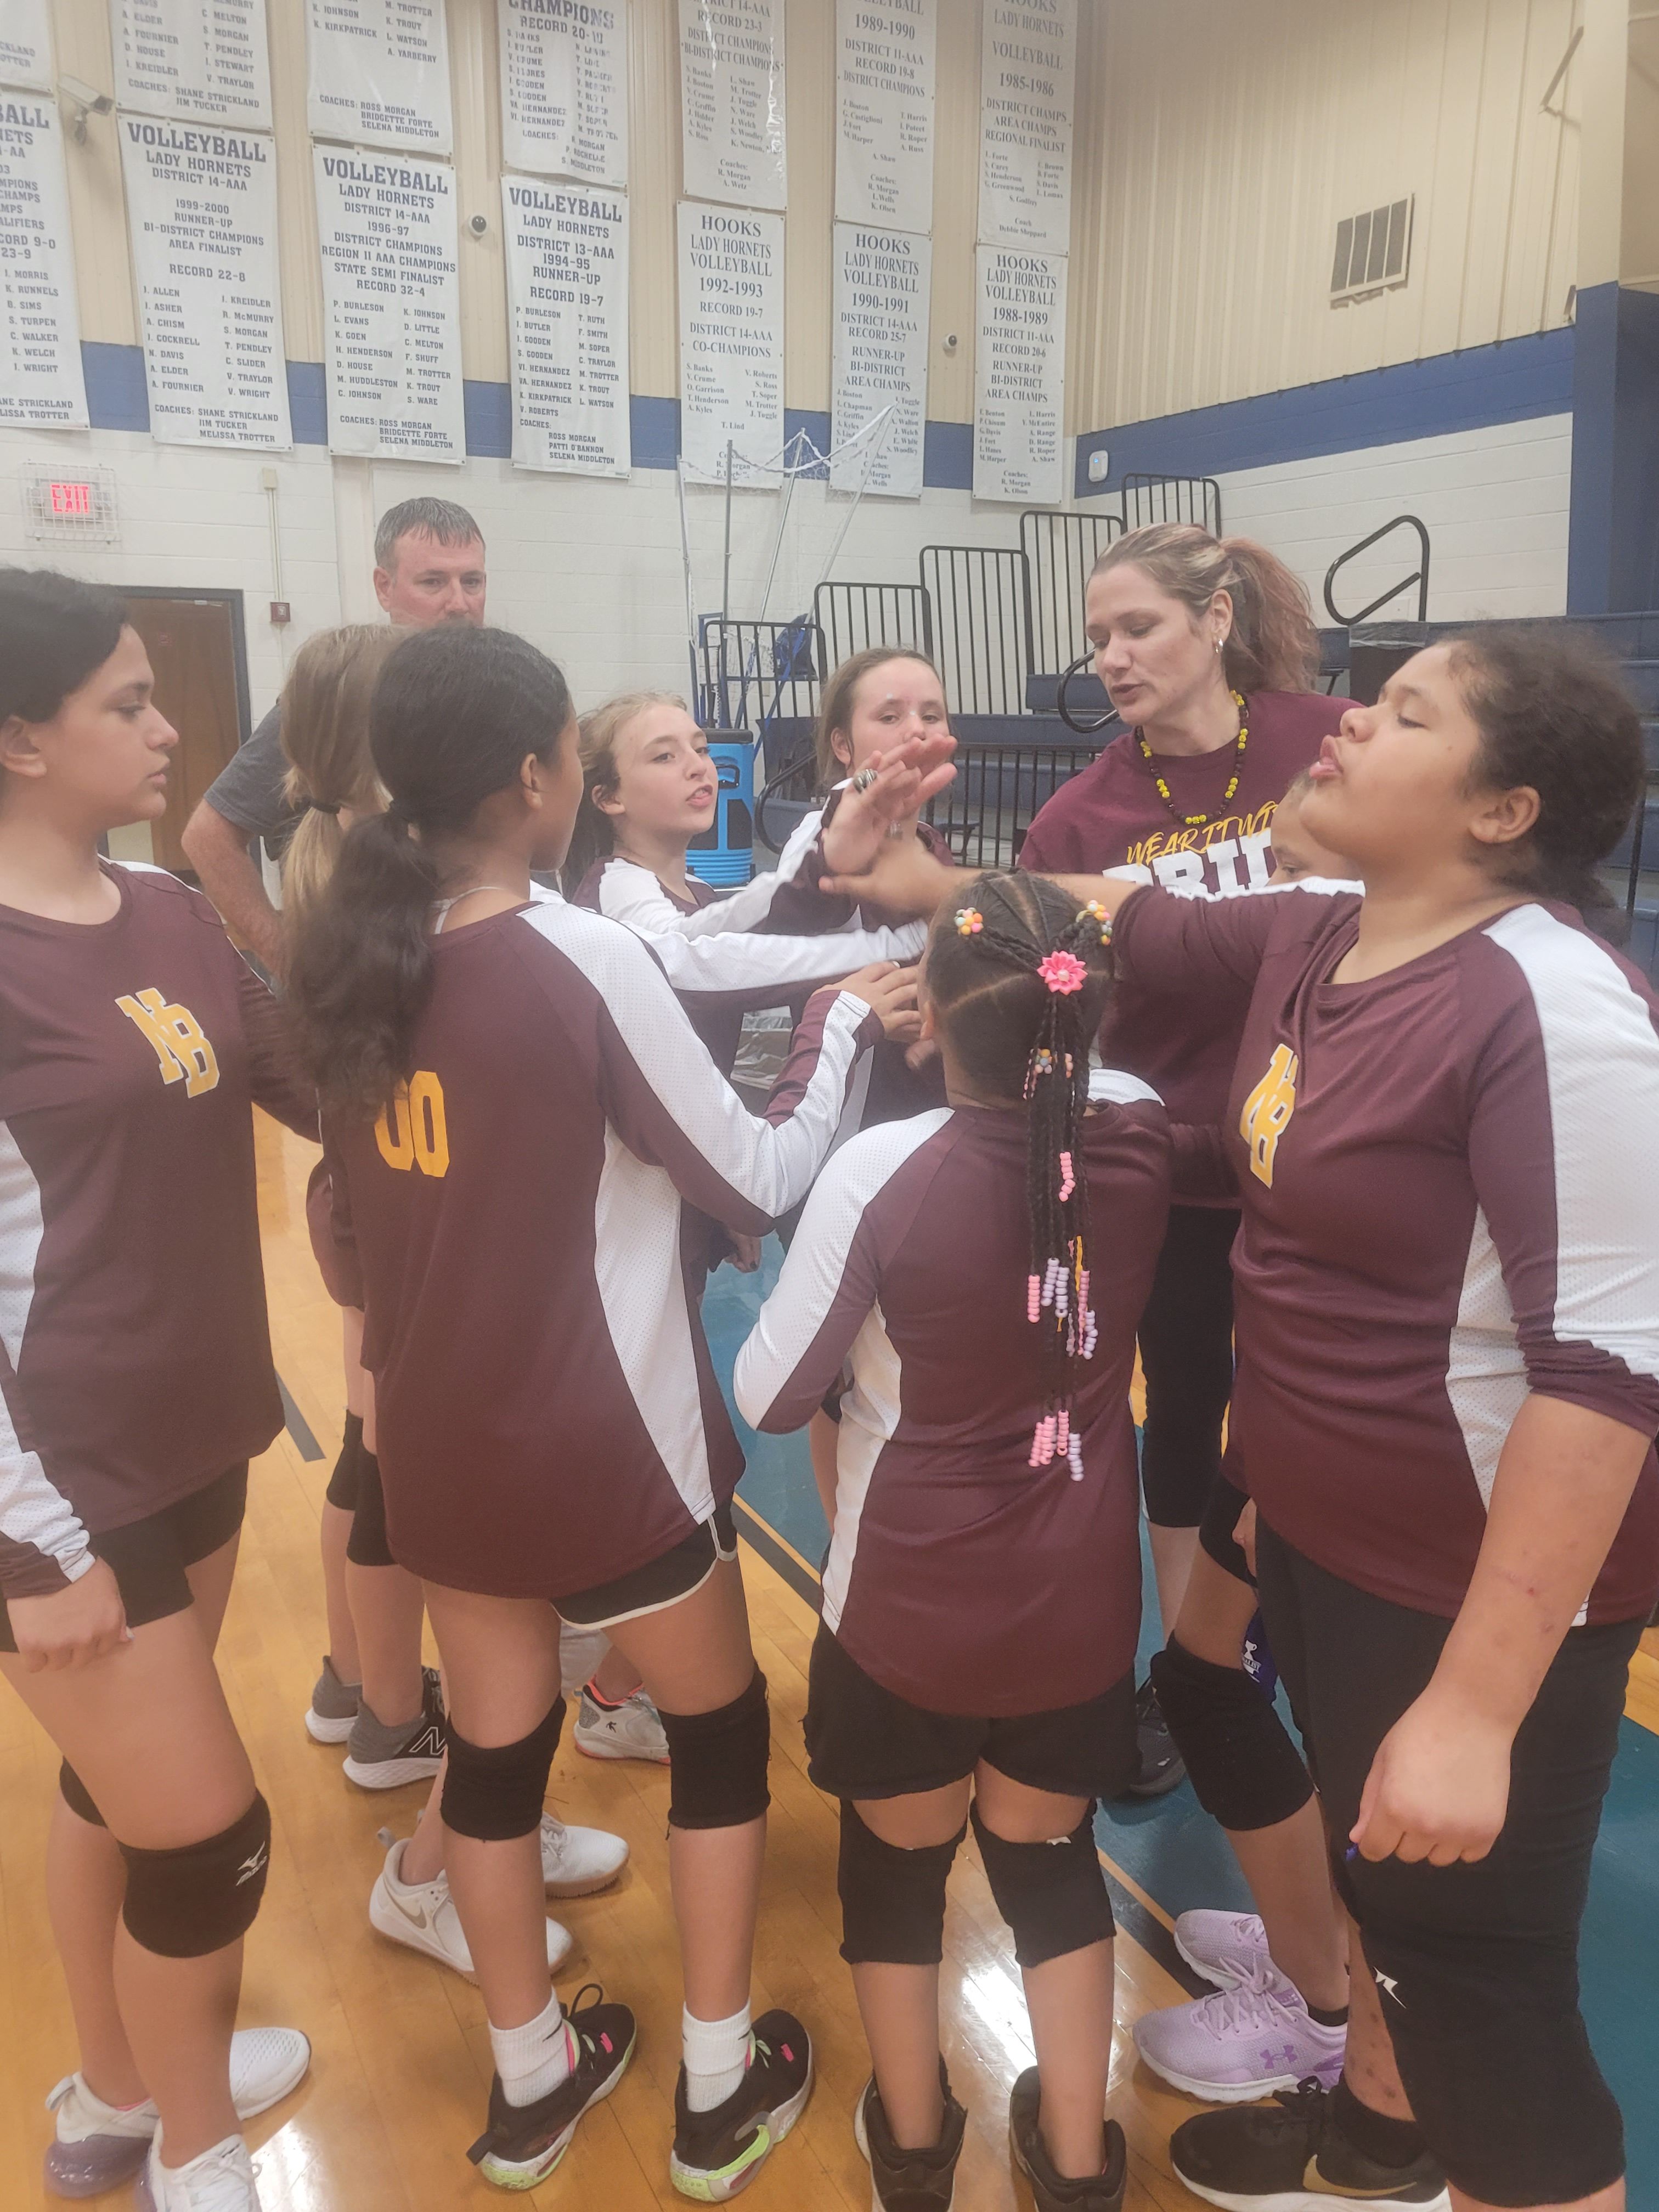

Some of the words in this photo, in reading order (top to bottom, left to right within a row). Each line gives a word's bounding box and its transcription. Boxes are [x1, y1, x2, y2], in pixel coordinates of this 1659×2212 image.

[856, 13, 915, 40] 1989-1990
[995, 9, 1020, 27] LADY
[1023, 15, 1064, 38] HORNETS
[398, 49, 437, 64] YARBERRY
[845, 38, 891, 57] DISTRICT
[992, 41, 1063, 70] VOLLEYBALL
[856, 57, 896, 75] RECORD
[900, 66, 915, 80] 19-8
[844, 70, 878, 87] DISTRICT
[881, 78, 924, 98] CHAMPIONS
[1000, 72, 1054, 97] 1985-1986
[176, 87, 204, 98] SHANE
[208, 93, 259, 108] STRICKLAND
[320, 94, 358, 109] COACHES:
[361, 102, 381, 111] ROSS
[385, 105, 416, 116] MORGAN
[986, 97, 1029, 114] DISTRICT
[1030, 105, 1066, 122] CHAMPS
[361, 111, 405, 125] BRIDGETTE
[408, 119, 432, 128] FORTE
[994, 116, 1019, 128] AREA
[1022, 120, 1057, 137] CHAMPS
[362, 121, 392, 132] SELENA
[396, 126, 439, 138] MIDDLETON
[127, 122, 266, 162] VOLLEYBALL
[986, 129, 1028, 146] REGIONAL
[1030, 137, 1065, 153] FINALIST
[146, 150, 180, 167] LADY
[188, 157, 251, 178] HORNETS
[153, 167, 204, 184] DISTRICT
[209, 176, 247, 191] 14-AAA
[323, 157, 448, 195] VOLLEYBALL
[339, 183, 370, 199] LADY
[377, 189, 434, 208] HORNETS
[509, 187, 622, 223] VOLLEYBALL
[176, 199, 229, 214] 1999-2000
[345, 202, 391, 218] DISTRICT
[396, 209, 430, 223] 14-AAA
[174, 212, 233, 228] RUNNER-UP
[368, 221, 409, 236] 1996-97
[523, 215, 551, 229] LADY
[557, 220, 609, 239] HORNETS
[702, 215, 761, 237] HOOKS
[144, 222, 205, 238] BI-DISTRICT
[210, 230, 264, 246] CHAMPIONS
[169, 239, 195, 251] AREA
[199, 242, 242, 256] FINALIST
[334, 232, 381, 247] DISTRICT
[386, 239, 442, 256] CHAMPIONS
[517, 235, 570, 253] DISTRICT
[575, 243, 614, 259] 13-AAA
[691, 234, 720, 251] LADY
[723, 238, 771, 259] HORNETS
[856, 233, 910, 255] HOOKS
[322, 245, 359, 259] REGION
[376, 253, 395, 264] AAA
[400, 256, 455, 273] CHAMPIONS
[544, 253, 590, 270] 1994-95
[691, 252, 772, 276] VOLLEYBALL
[845, 251, 872, 268] LADY
[875, 256, 919, 275] HORNETS
[997, 255, 1048, 273] HOOKS
[170, 263, 213, 278] RECORD
[335, 263, 366, 275] STATE
[371, 267, 396, 279] SEMI
[400, 271, 444, 285] FINALIST
[533, 266, 600, 285] RUNNER-UP
[987, 268, 1012, 284] LADY
[1014, 272, 1056, 290] HORNETS
[19, 285, 59, 296] RUNNELS
[357, 280, 396, 293] RECORD
[400, 285, 425, 297] 32-4
[700, 276, 763, 297] 1992-1993
[844, 269, 918, 293] VOLLEYBALL
[531, 286, 574, 302] RECORD
[580, 293, 603, 306] 19-7
[853, 292, 908, 313] 1990-1991
[986, 285, 1056, 306] VOLLEYBALL
[344, 302, 384, 312] BURLESON
[700, 301, 742, 316] RECORD
[746, 307, 763, 318] 19-7
[994, 307, 1048, 325] 1988-1989
[21, 318, 56, 326] TURPEN
[158, 319, 185, 329] CHISM
[841, 312, 885, 327] DISTRICT
[888, 318, 917, 332] 14-AAA
[588, 330, 608, 339] SMITH
[690, 323, 736, 337] DISTRICT
[740, 328, 772, 341] 14-AAA
[849, 326, 888, 341] RECORD
[891, 332, 906, 342] 25-7
[983, 326, 1024, 340] DISTRICT
[347, 347, 393, 358] HENDERSON
[415, 340, 444, 349] MELTON
[693, 340, 771, 358] CO-CHAMPIONS
[853, 346, 905, 362] RUNNER-UP
[992, 342, 1029, 356] RECORD
[1032, 347, 1046, 358] 20-6
[850, 361, 905, 377] BI-DISTRICT
[993, 360, 1042, 374] RUNNER-UP
[696, 385, 724, 393] Garrison
[845, 376, 871, 387] AREA
[874, 378, 910, 392] CHAMPS
[991, 375, 1042, 389] BI-DISTRICT
[19, 399, 73, 409] STRICKLAND
[986, 389, 1010, 399] AREA
[1013, 390, 1048, 403] CHAMPS
[29, 411, 69, 420] TROTTER
[155, 404, 194, 415] COACHES:
[198, 409, 225, 417] SHANE
[229, 411, 278, 421] STRICKLAND
[529, 407, 558, 416] ROBERTS
[200, 430, 235, 439] MELISSA
[239, 433, 275, 443] TROTTER
[50, 483, 89, 513] EXIT
